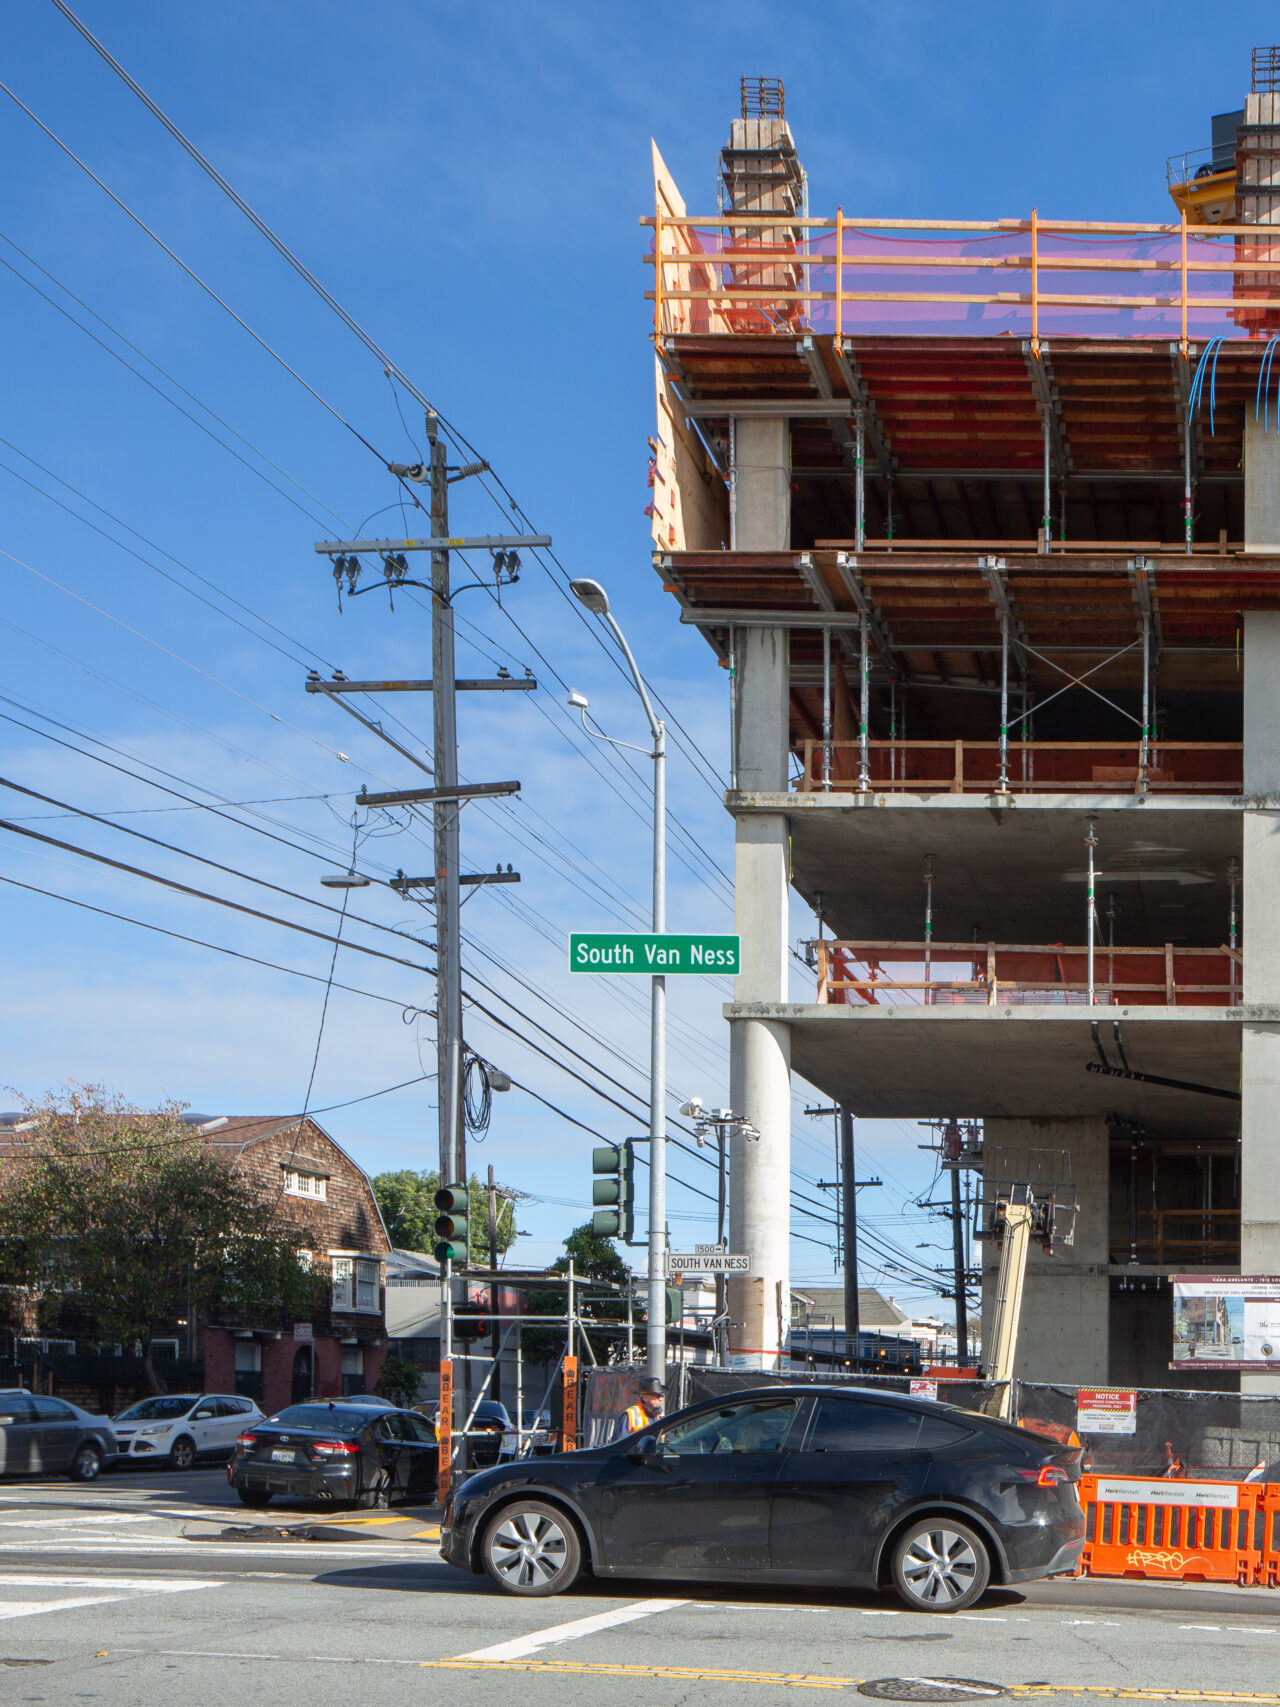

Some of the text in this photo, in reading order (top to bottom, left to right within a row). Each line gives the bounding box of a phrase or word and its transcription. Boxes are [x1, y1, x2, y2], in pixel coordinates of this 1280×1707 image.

[576, 942, 735, 966] South Van Ness
[671, 1258, 748, 1269] SOUTH VAN NESS
[440, 1383, 449, 1426] BEAR
[566, 1378, 574, 1422] BEAR
[440, 1447, 449, 1489] BEAR
